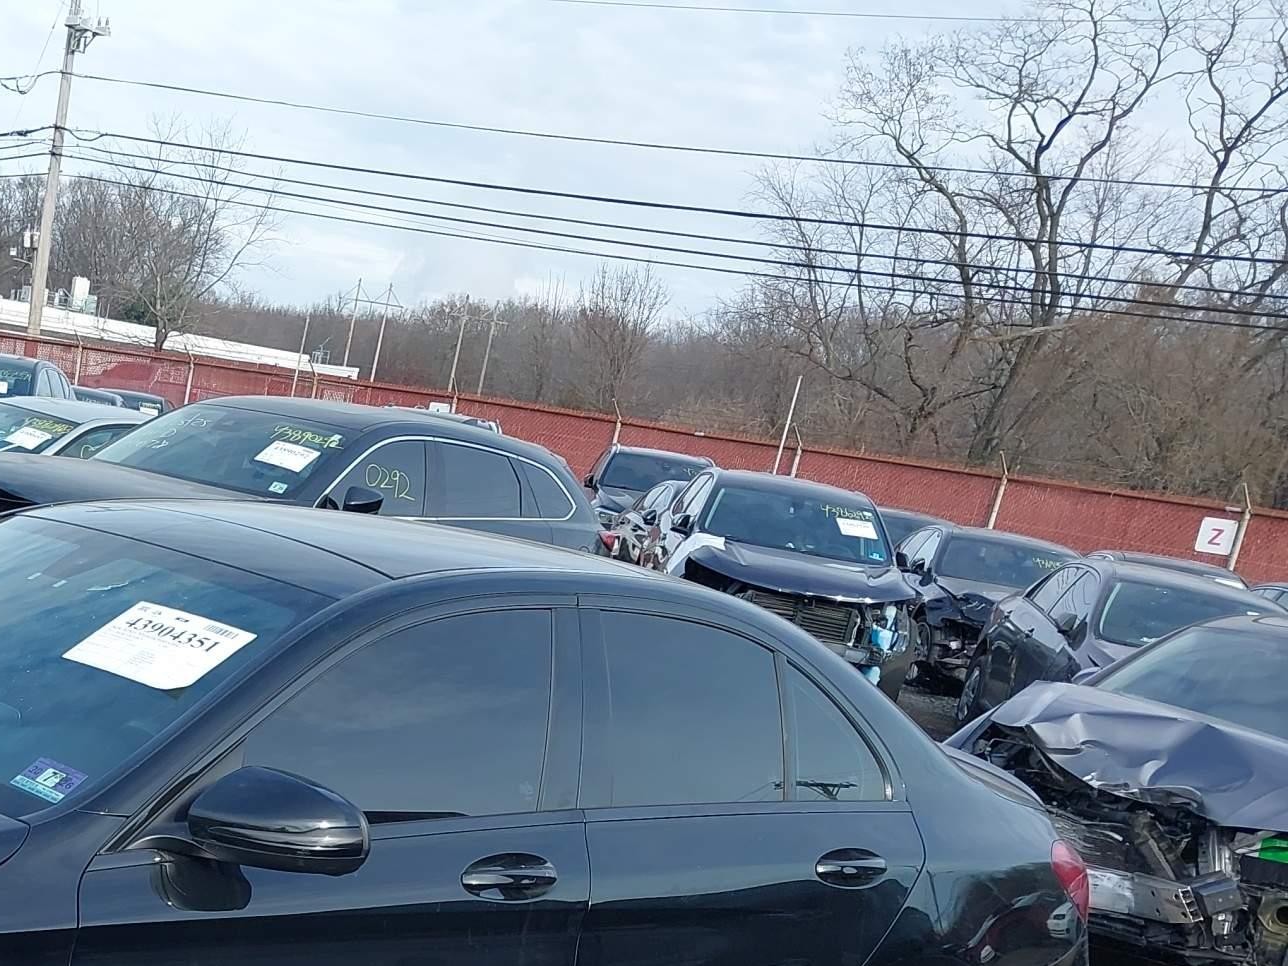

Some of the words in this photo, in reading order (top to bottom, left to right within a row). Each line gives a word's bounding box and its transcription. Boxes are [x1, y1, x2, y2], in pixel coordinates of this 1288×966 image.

[365, 463, 415, 501] 0292
[1207, 527, 1225, 546] Z
[125, 617, 220, 652] 43904351
